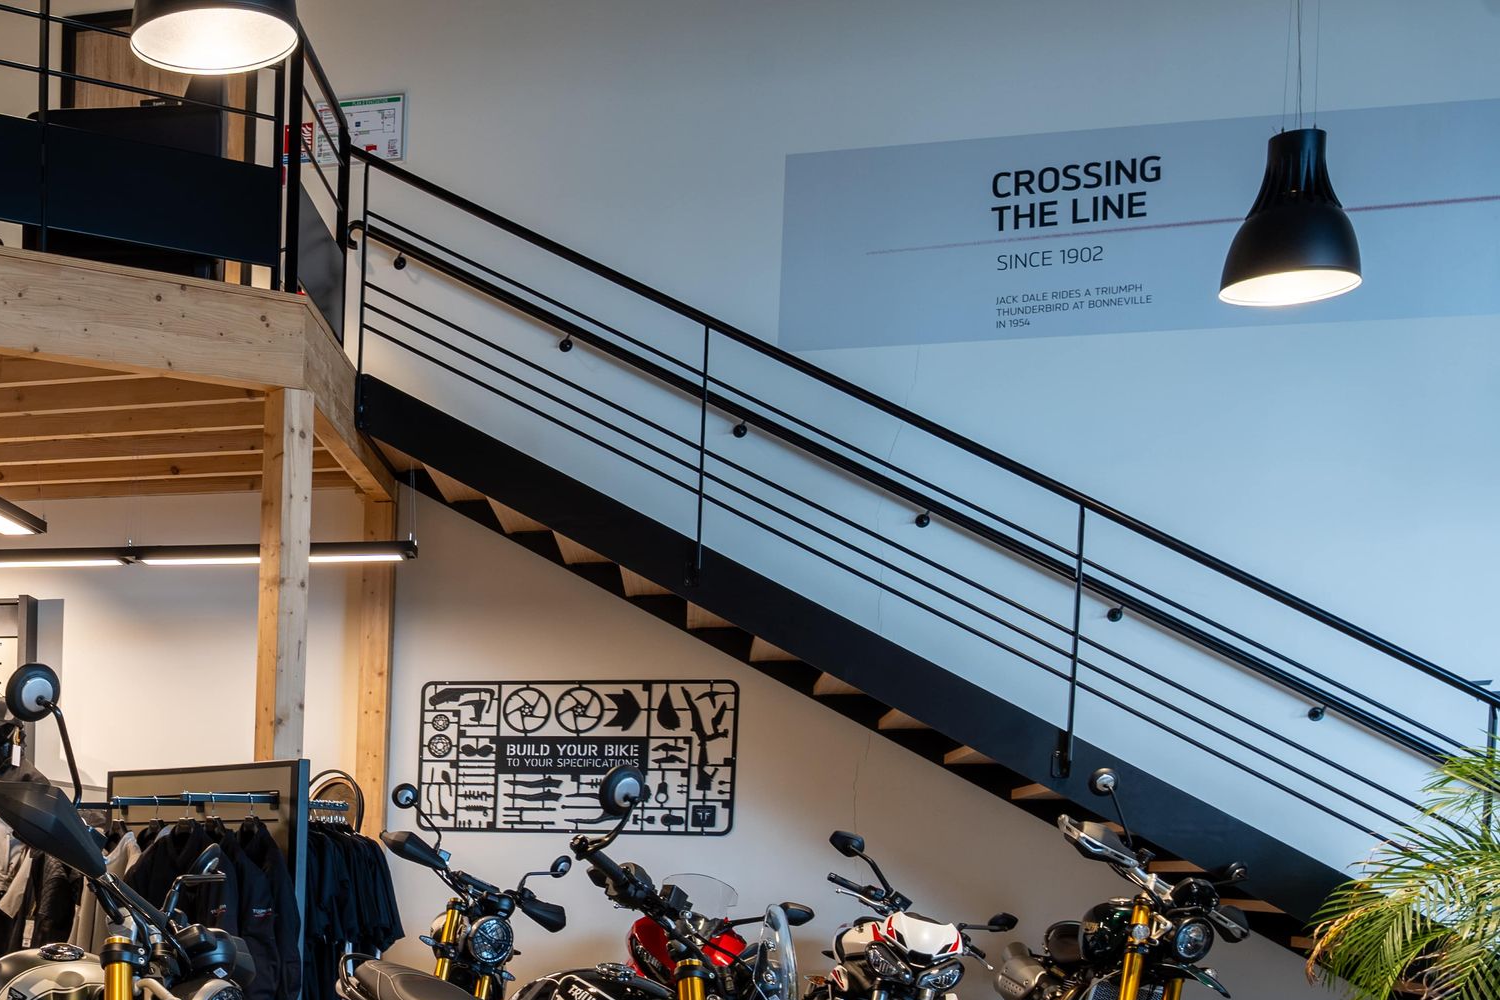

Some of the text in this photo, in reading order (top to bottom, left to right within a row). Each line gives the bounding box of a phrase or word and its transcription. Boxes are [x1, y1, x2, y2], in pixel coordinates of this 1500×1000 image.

[992, 155, 1161, 198] CROSSING
[991, 191, 1147, 231] THE LINE
[997, 246, 1104, 271] SINCE 1902
[996, 283, 1143, 305] JACK DALE RIDES A TRIUMPH
[996, 294, 1153, 317] THUNDERBIRD AT BONNEVILLE
[996, 318, 1031, 329] IN 1954
[506, 744, 639, 757] BUILD YOUR BIKE
[506, 758, 639, 768] TO YOUR SPECIFICATIONS
